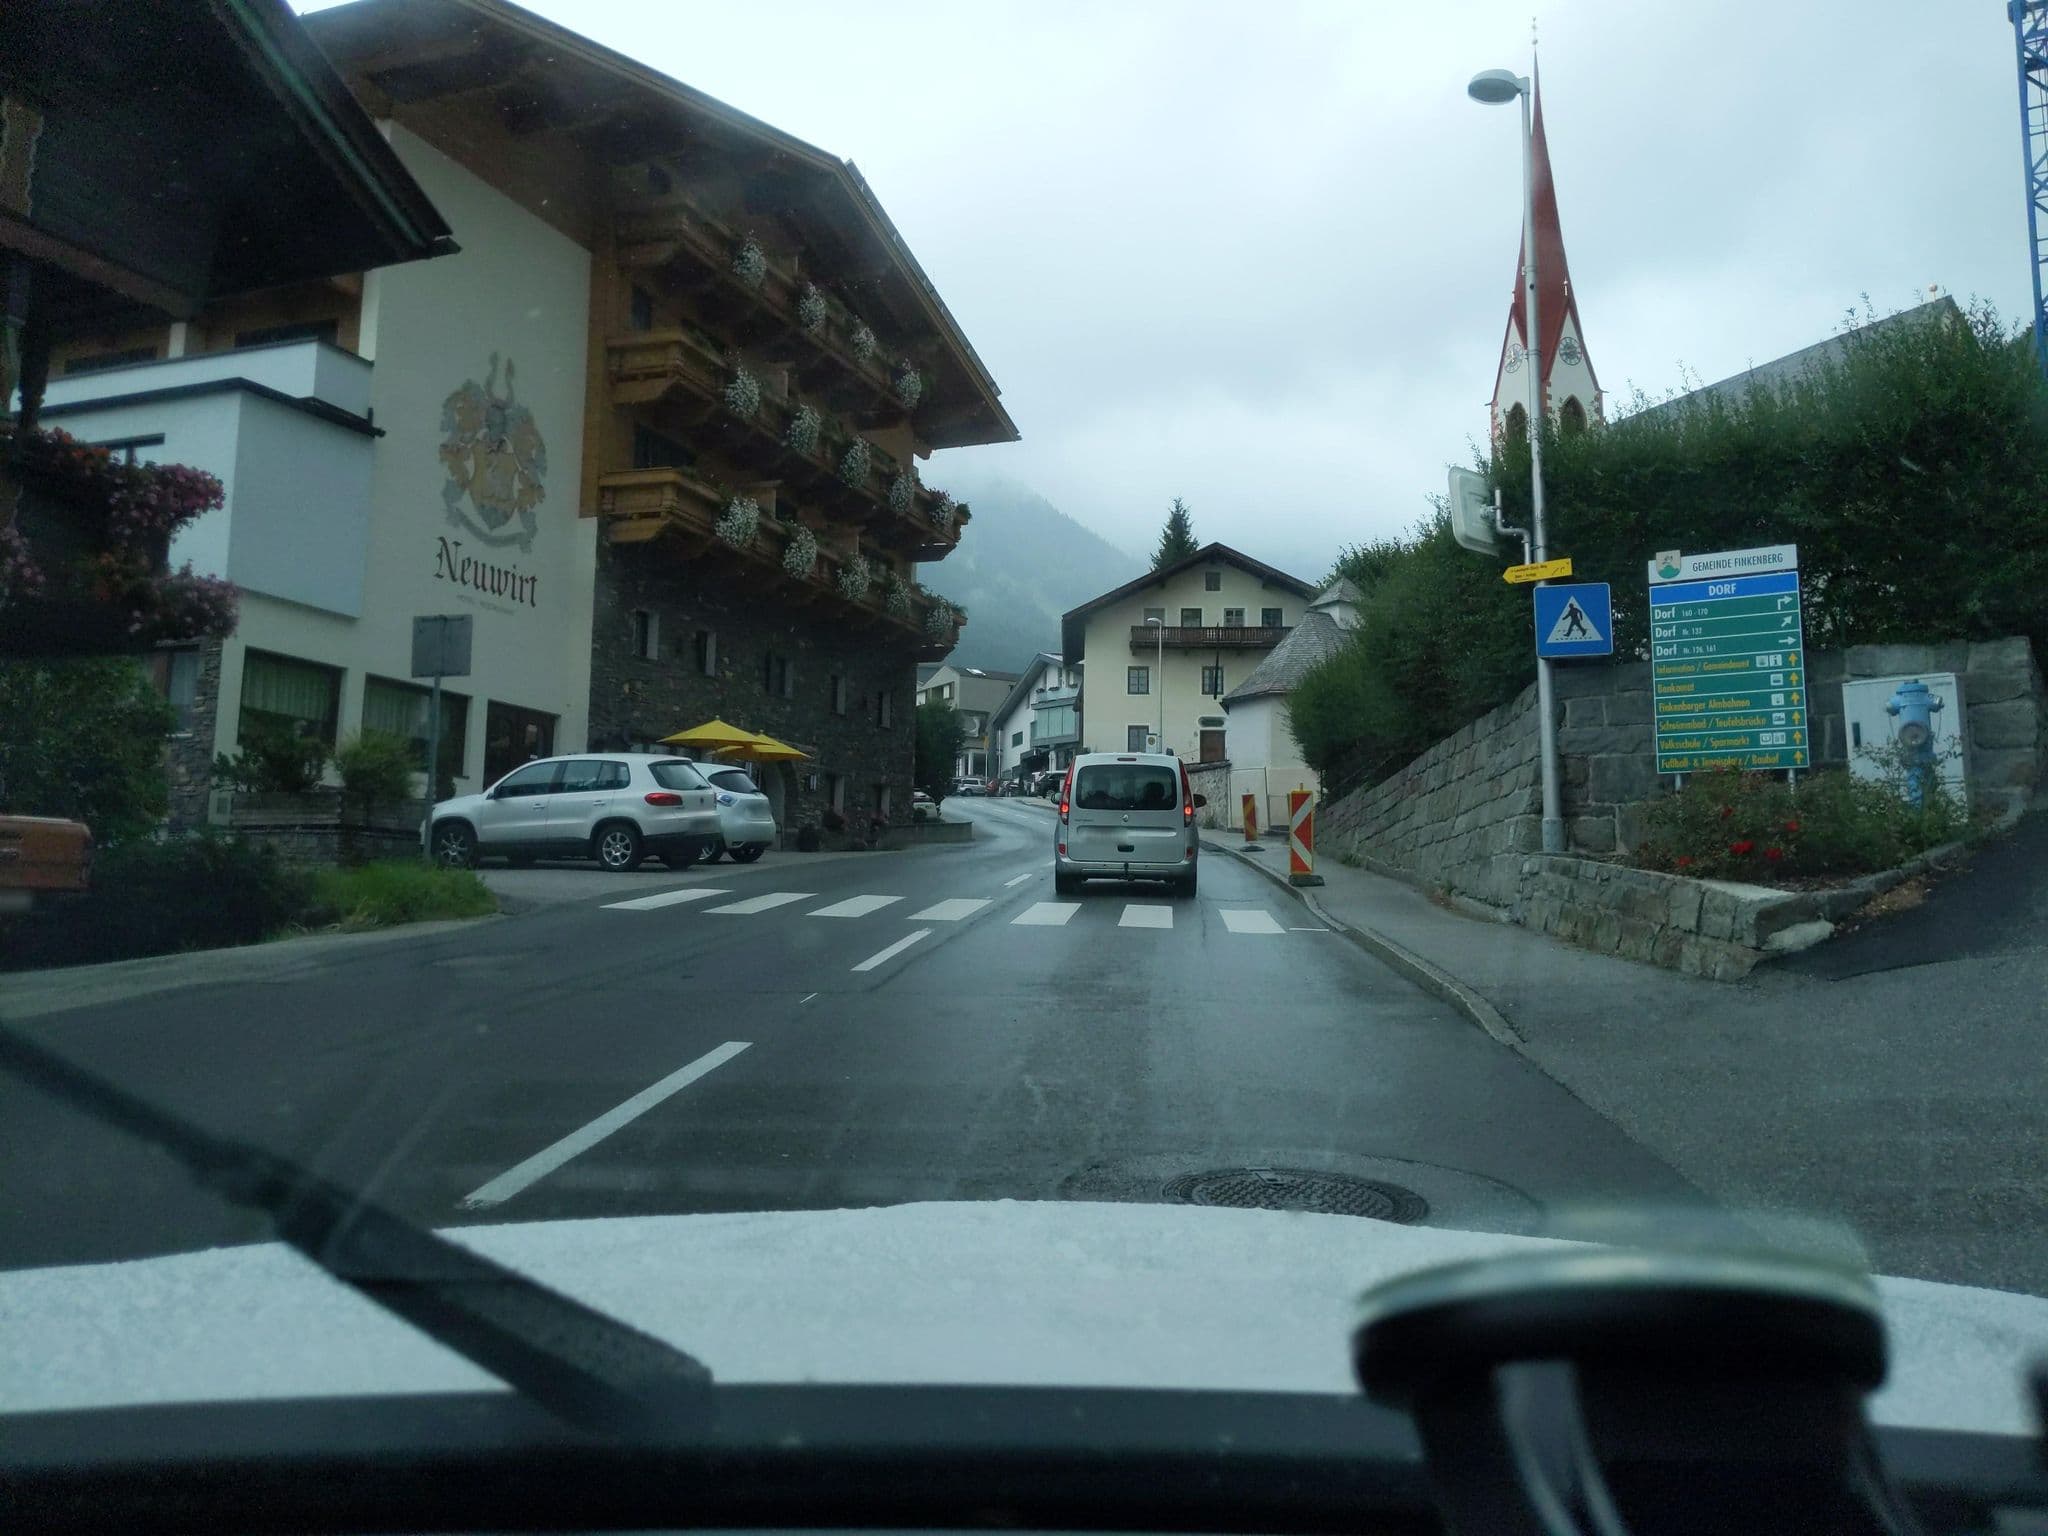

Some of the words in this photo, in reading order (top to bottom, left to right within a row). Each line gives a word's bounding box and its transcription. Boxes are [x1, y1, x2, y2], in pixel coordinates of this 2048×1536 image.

[1692, 559, 1732, 572] GEMEINDE
[1734, 553, 1784, 567] FINKENBERG
[433, 536, 538, 608] Neuwirt
[1708, 583, 1737, 596] DORF
[1654, 606, 1676, 620] Dorf
[1682, 609, 1693, 617] 160
[1698, 607, 1709, 616] 170
[1655, 625, 1677, 638] Dorf
[1656, 643, 1678, 657] Dorf
[1706, 644, 1717, 653] 161
